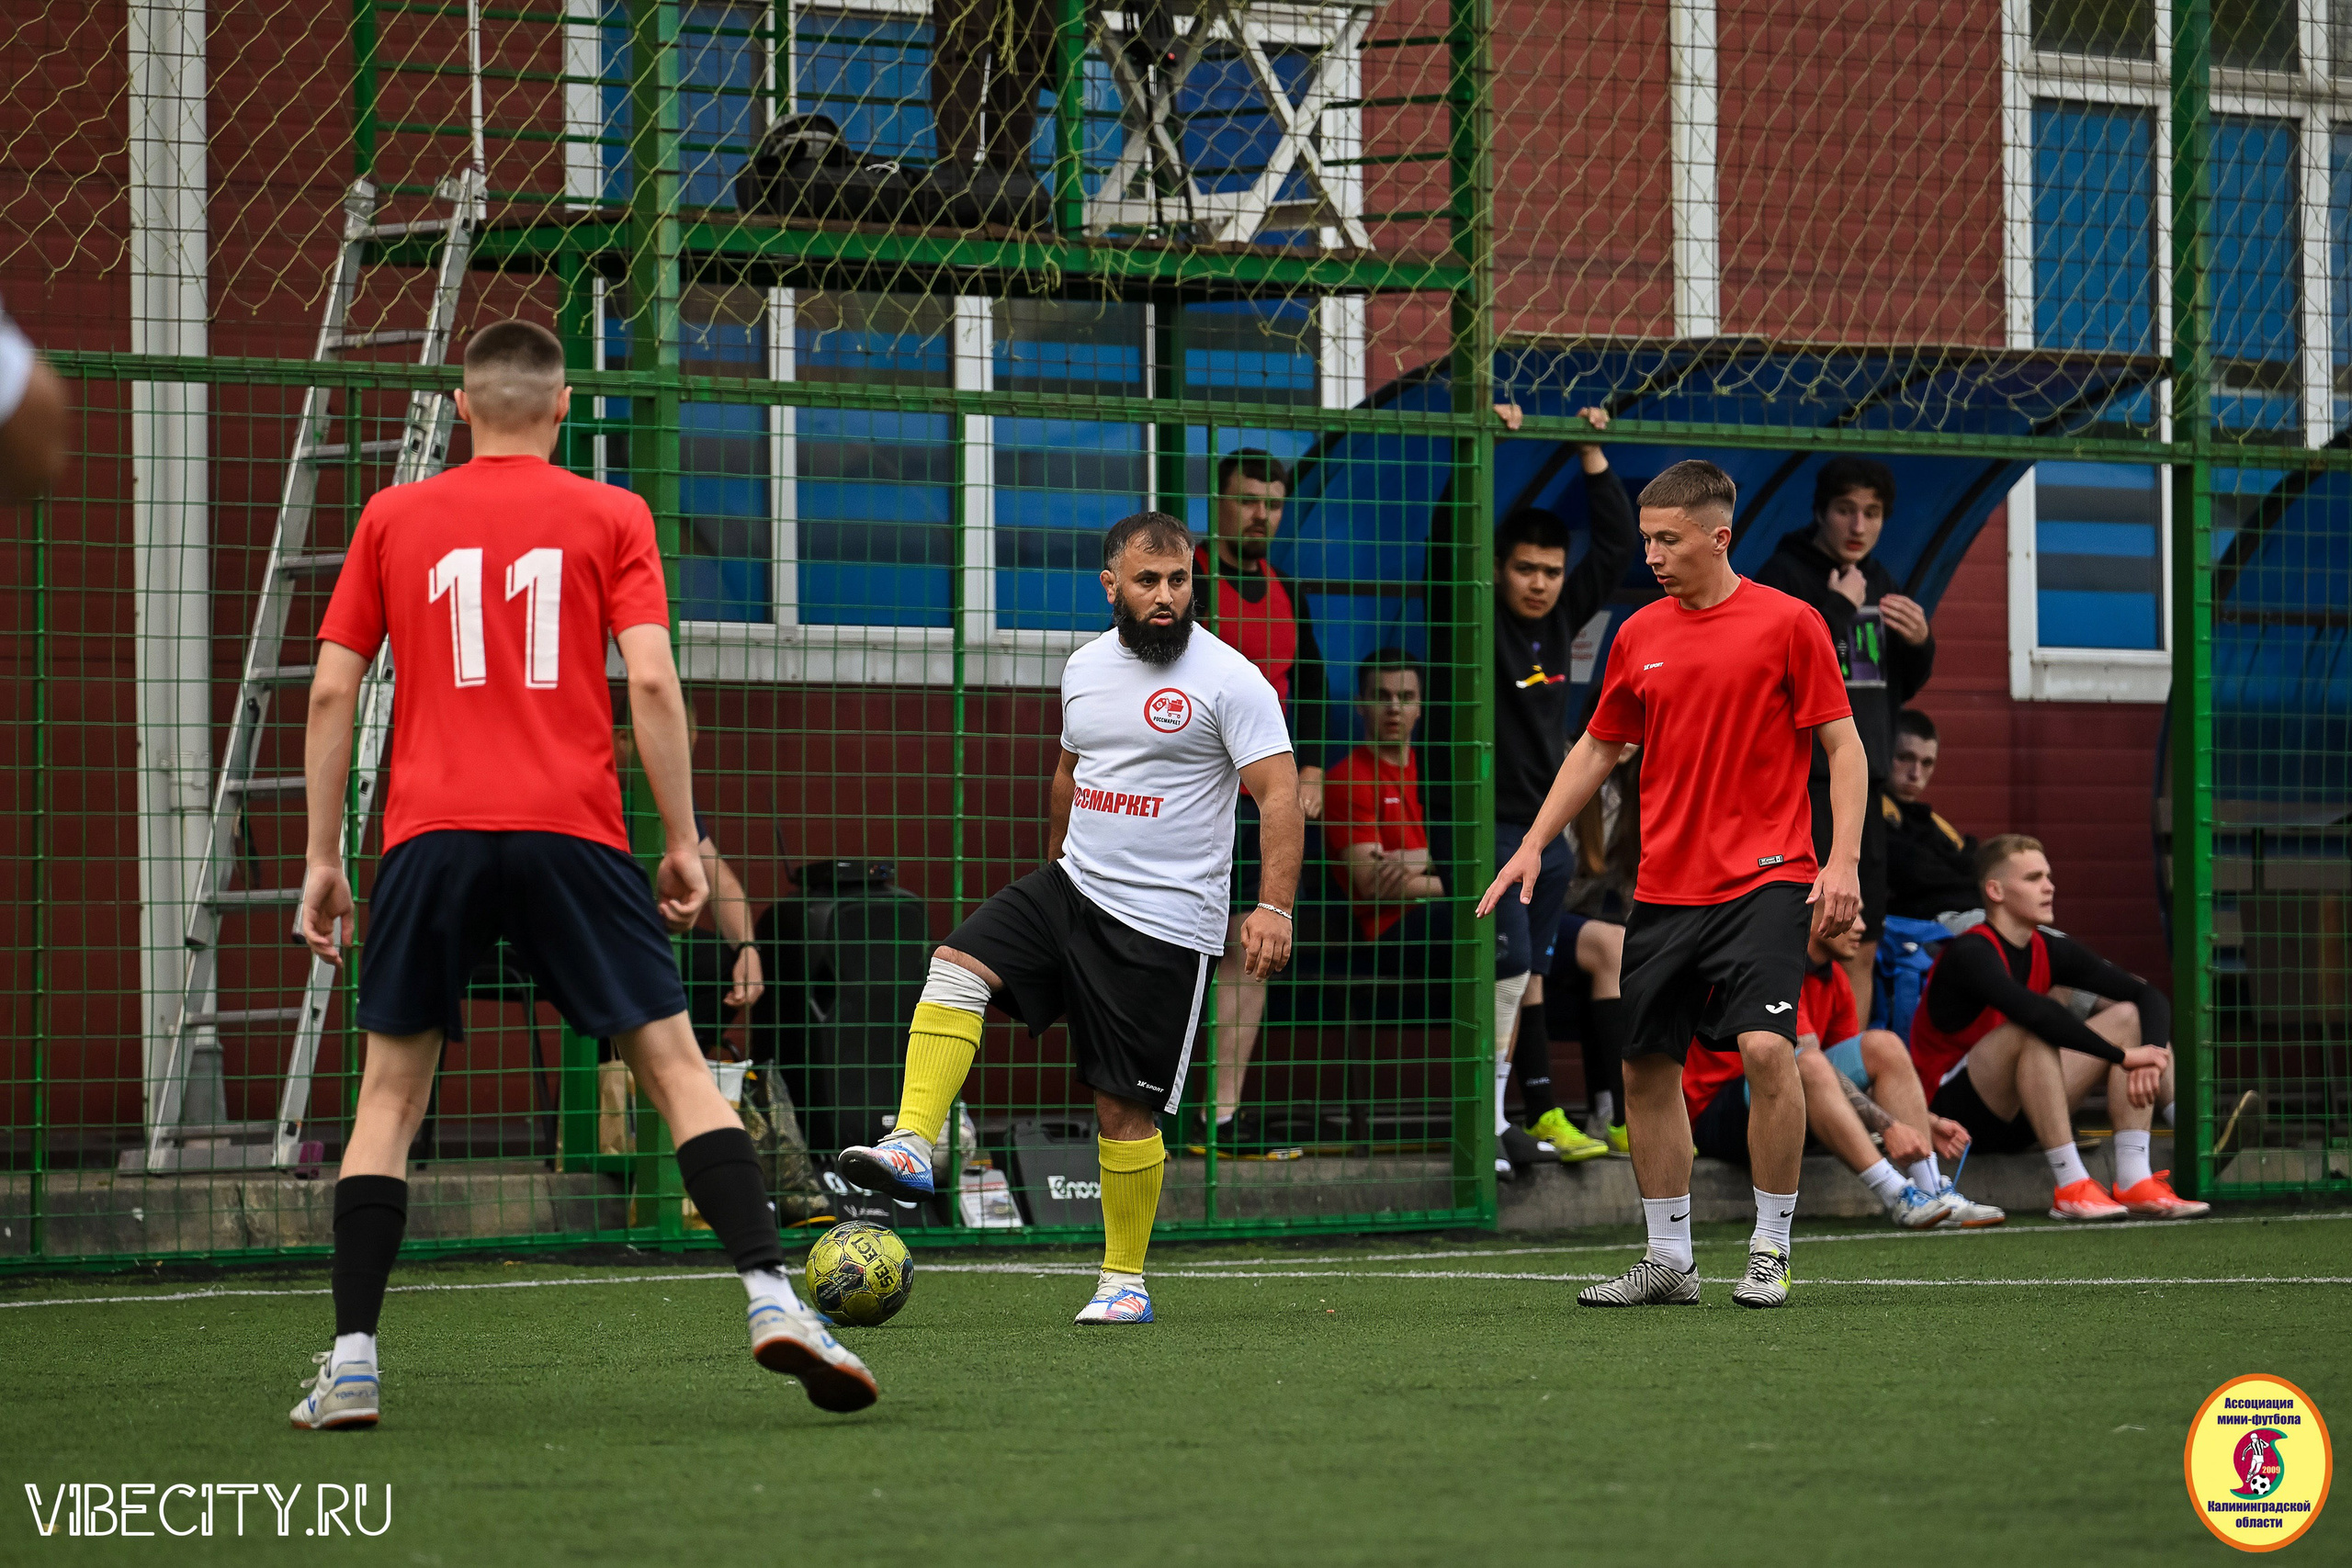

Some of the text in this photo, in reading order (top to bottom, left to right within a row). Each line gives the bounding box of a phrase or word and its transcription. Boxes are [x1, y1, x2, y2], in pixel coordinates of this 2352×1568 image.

[428, 547, 563, 690] 11
[1153, 716, 1181, 726] РОССМАРКЕТ
[1145, 1084, 1164, 1093] SPORT
[850, 1236, 895, 1289] SELECT
